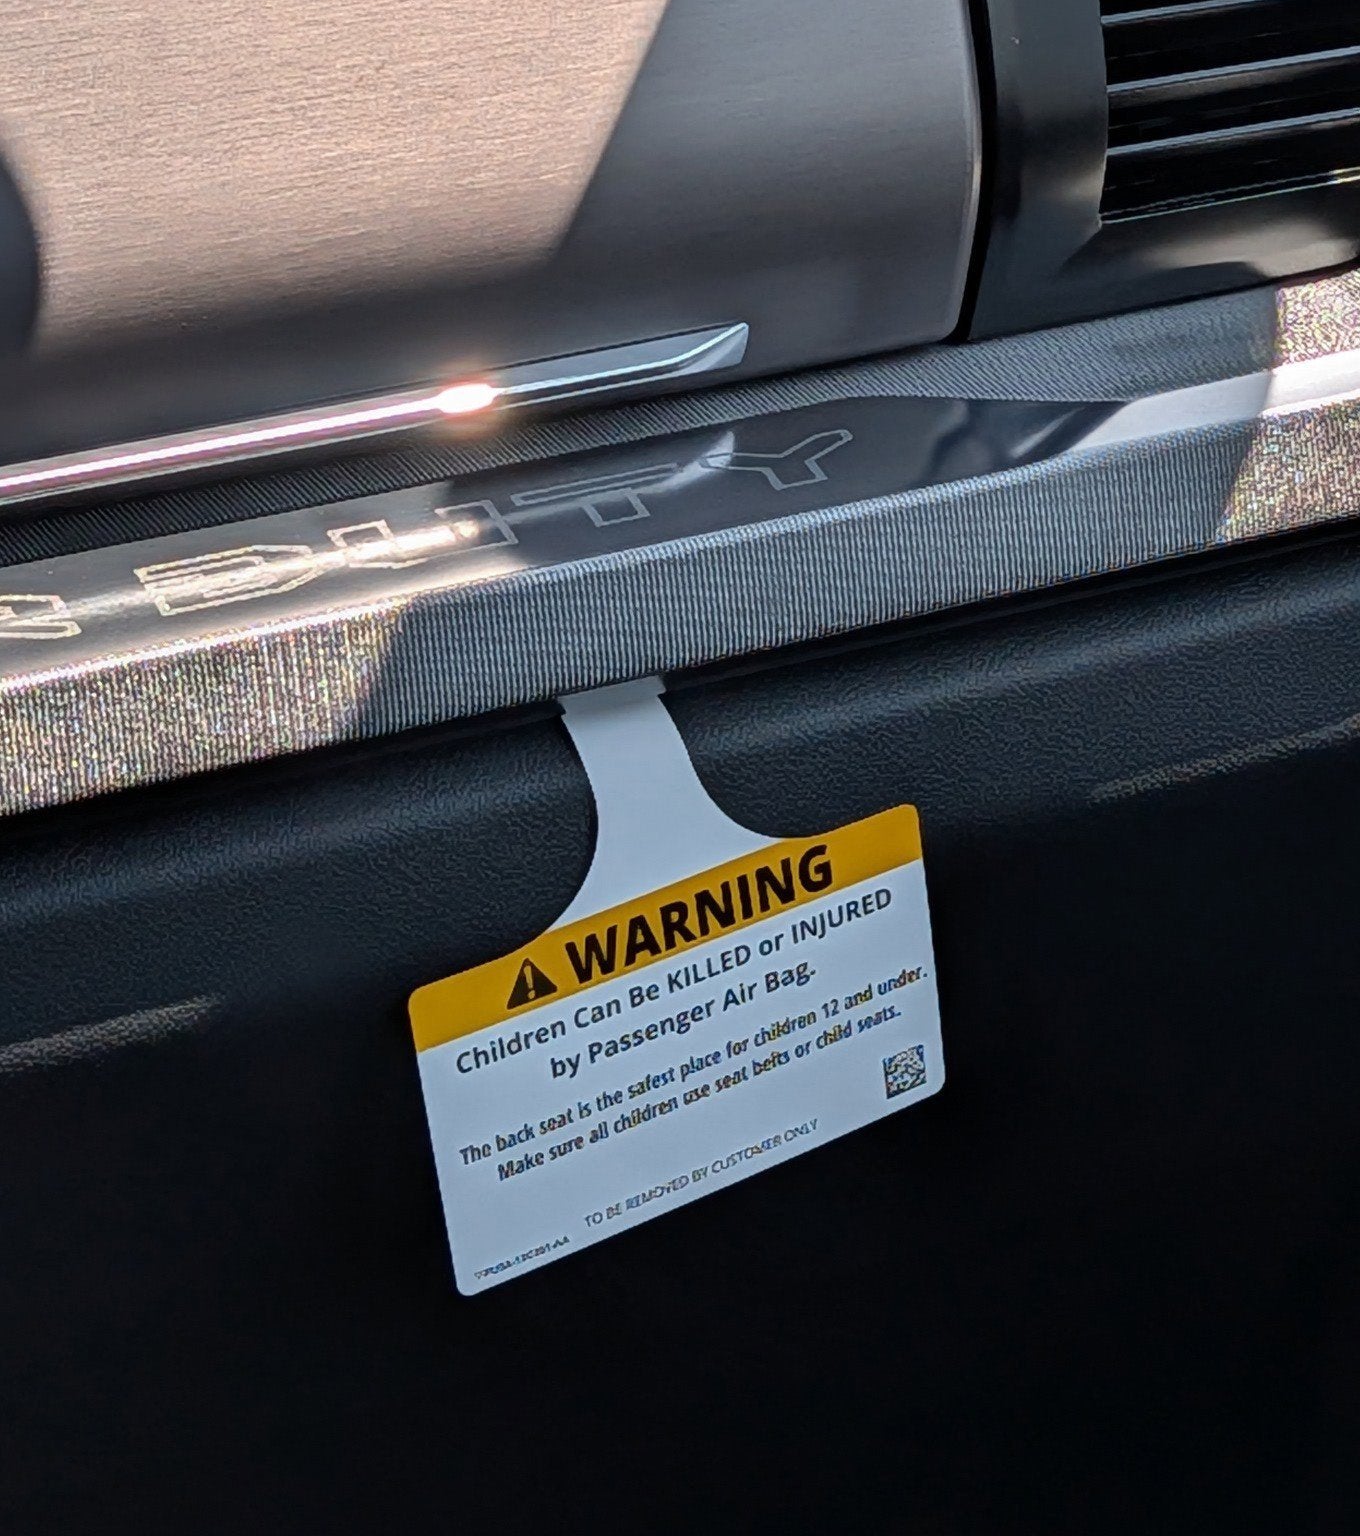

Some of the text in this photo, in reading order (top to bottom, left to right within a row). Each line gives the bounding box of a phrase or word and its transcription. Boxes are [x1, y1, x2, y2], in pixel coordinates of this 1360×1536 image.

[456, 888, 892, 1074] Children Can Be KILLED or INJURED
[565, 845, 832, 984] WARNING
[458, 966, 928, 1165] The back seat is the safest place for children 12 and under.
[497, 1152, 544, 1182] Make
[548, 1136, 585, 1161] sure
[589, 1121, 609, 1144] all
[613, 1097, 679, 1134] children
[683, 1084, 711, 1106] use
[714, 1066, 749, 1093] seat
[794, 1040, 812, 1058] or
[815, 1019, 853, 1049] child
[857, 1005, 902, 1034] seats.
[550, 962, 816, 1079] by Passenger Air Bag.
[583, 1211, 603, 1232] TO
[605, 1202, 623, 1220] BE
[691, 1166, 708, 1183] BY
[711, 1134, 782, 1174] CUSTOMER
[783, 1118, 818, 1142] ONLY
